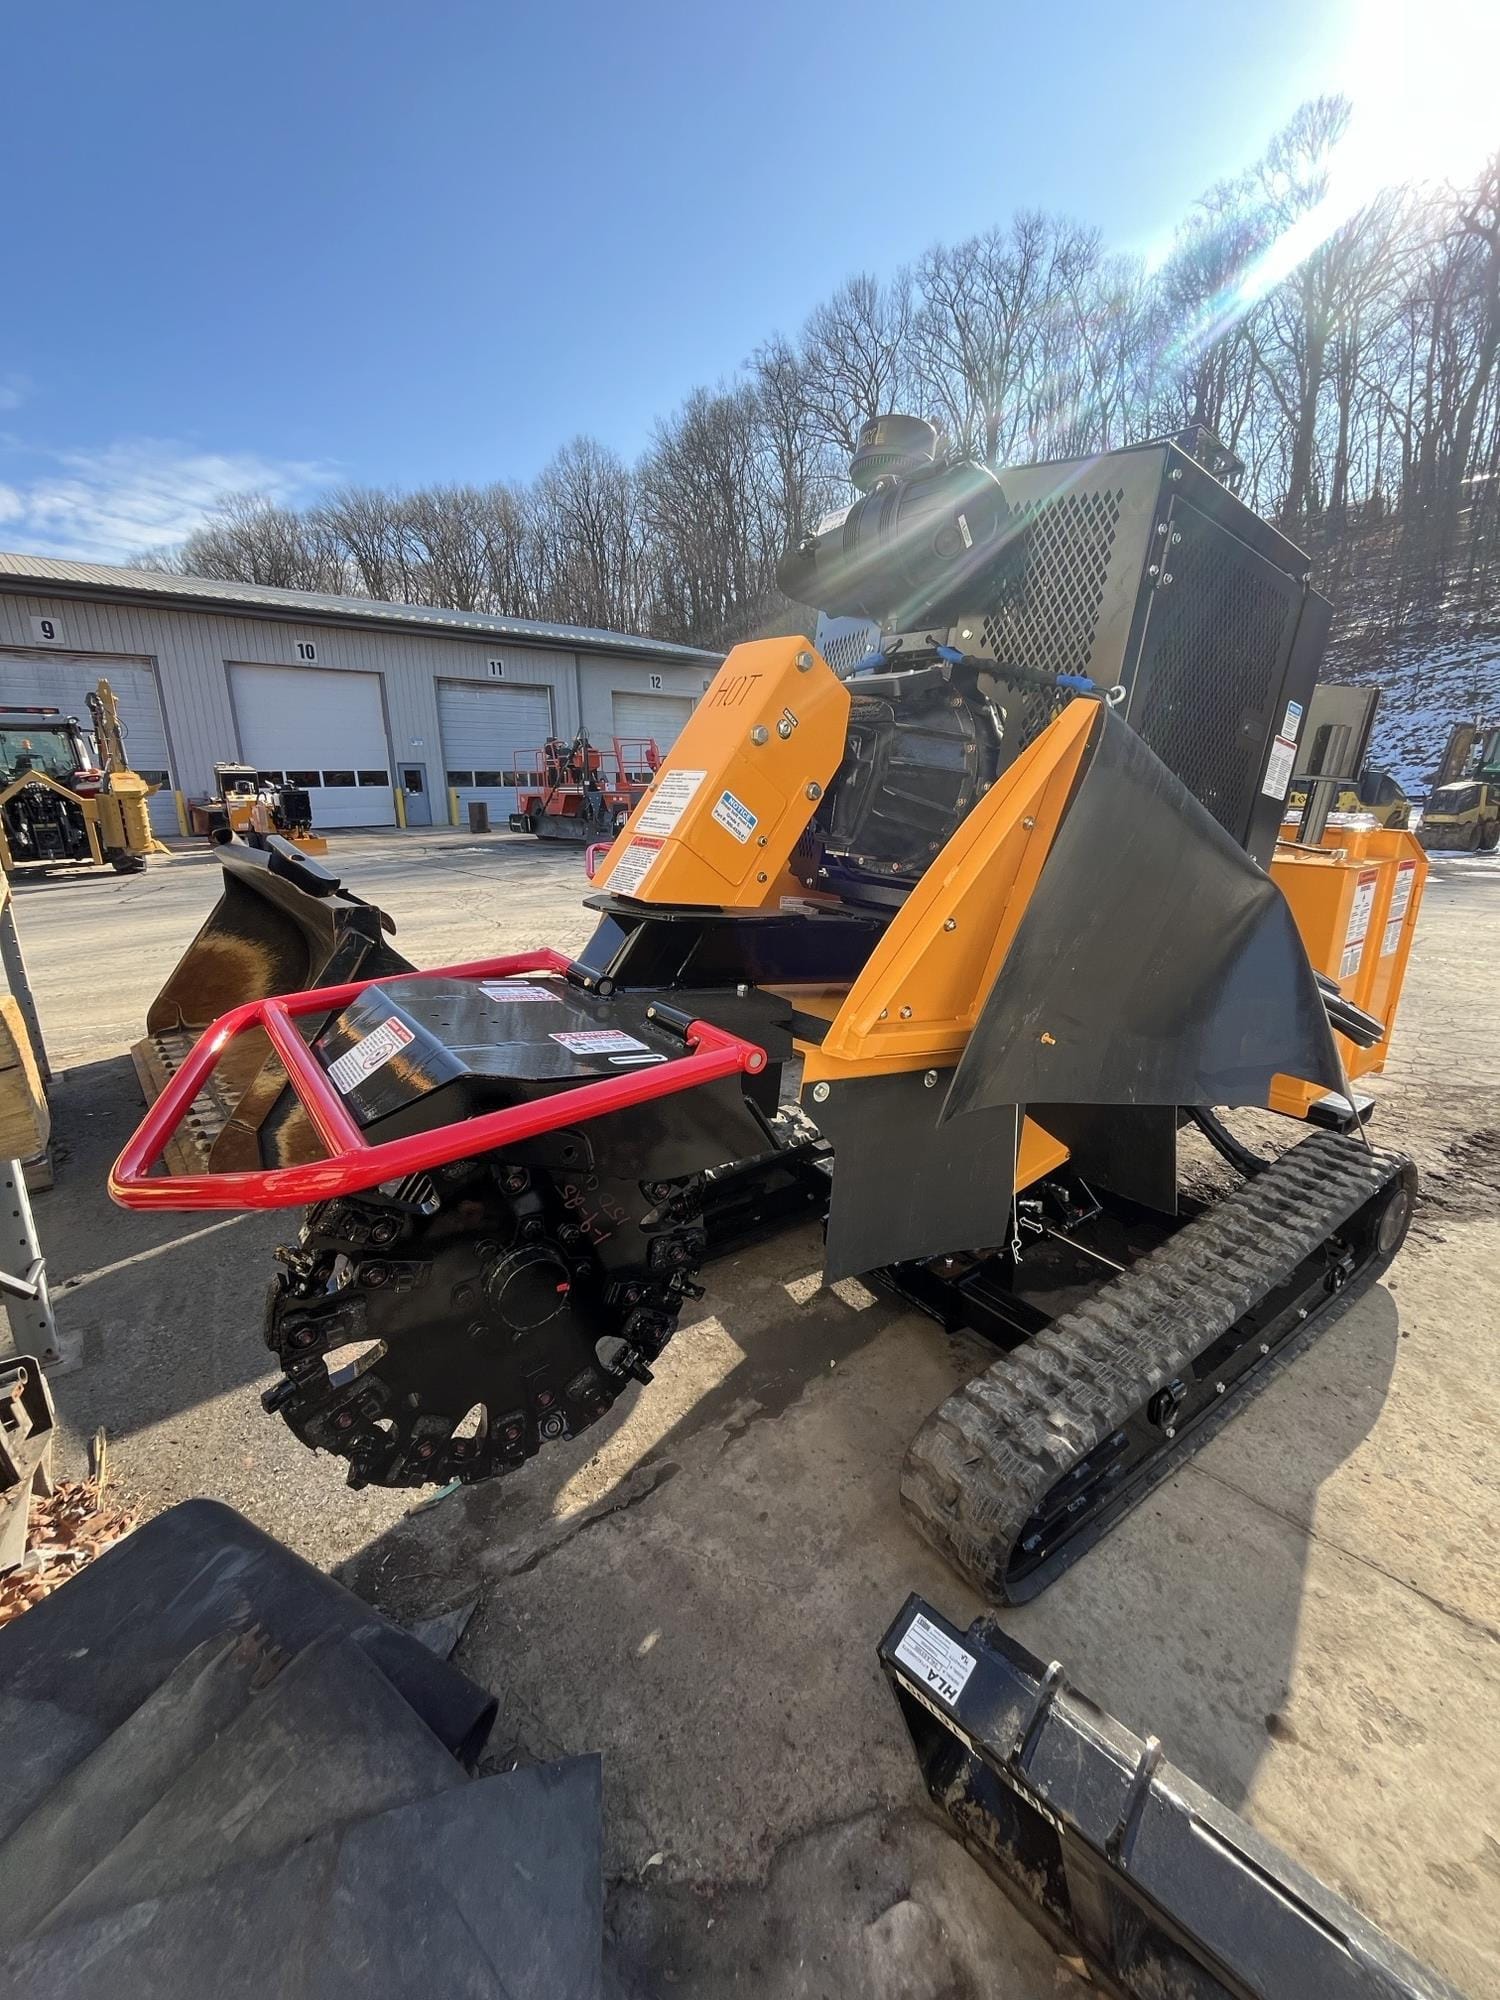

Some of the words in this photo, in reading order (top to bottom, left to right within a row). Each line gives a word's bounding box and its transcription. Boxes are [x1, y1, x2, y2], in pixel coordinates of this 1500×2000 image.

[41, 620, 55, 640] 9
[297, 643, 315, 660] 10
[490, 661, 503, 676] 11
[650, 675, 662, 689] 12
[708, 673, 764, 708] HOT
[728, 797, 753, 823] NOTICE
[554, 1184, 612, 1246] 1-9-25
[927, 1668, 958, 1701] HLA
